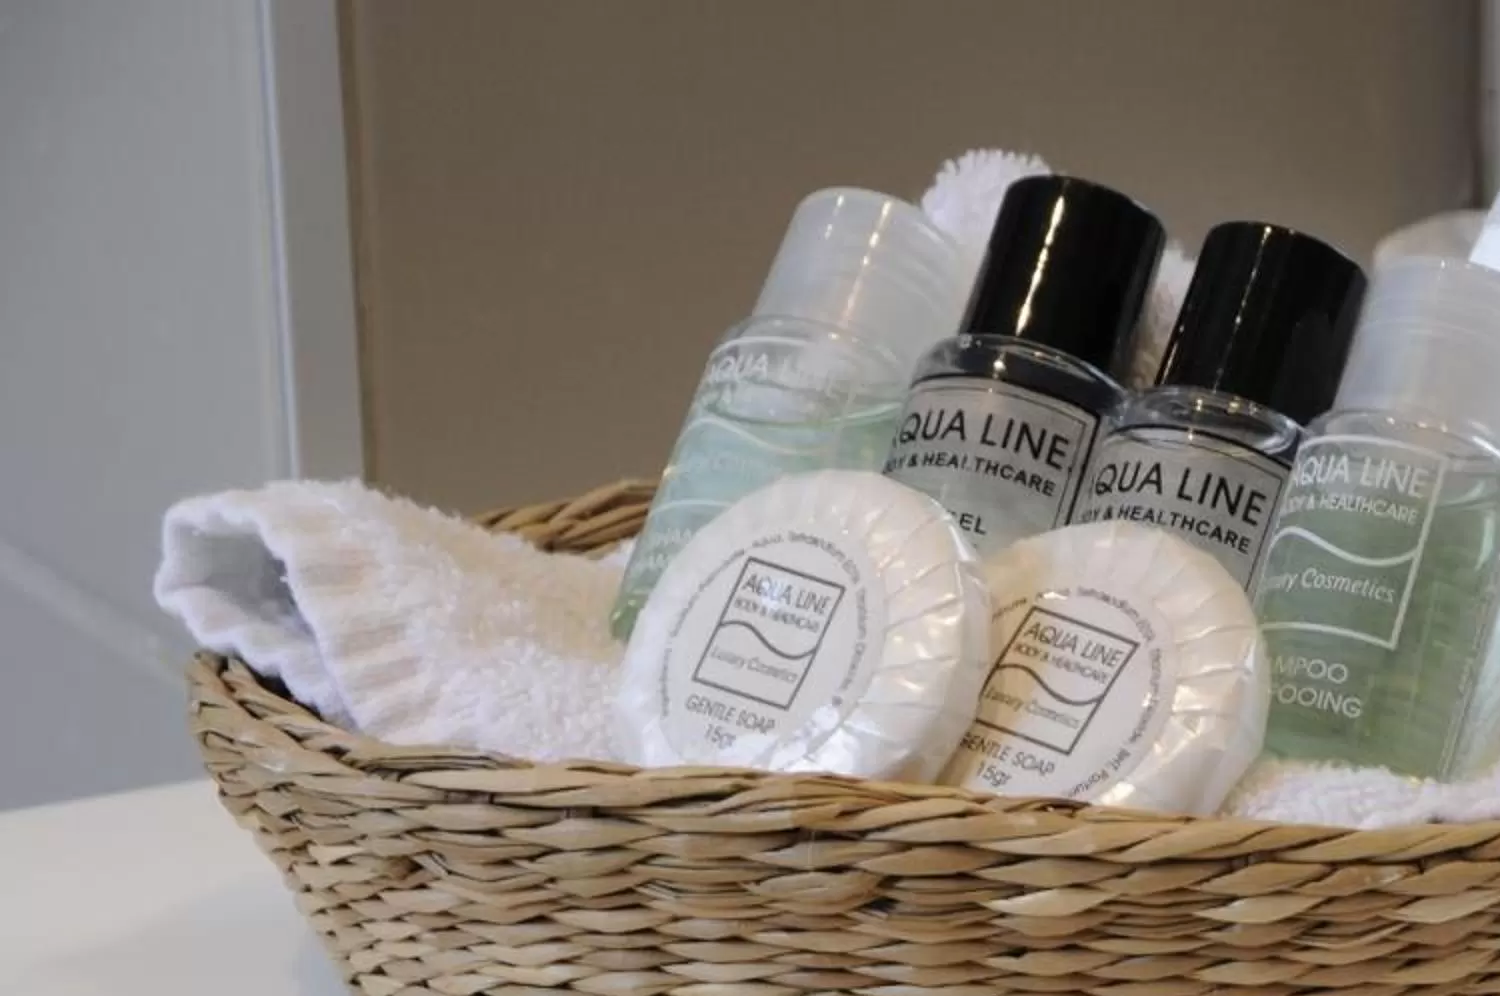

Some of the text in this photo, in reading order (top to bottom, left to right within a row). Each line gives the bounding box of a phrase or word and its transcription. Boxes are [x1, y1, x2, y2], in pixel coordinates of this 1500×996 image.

[893, 409, 1069, 470] QUA LINE
[921, 451, 1056, 497] HEALTHCARE
[1090, 461, 1266, 526] QUA LINE
[1359, 456, 1429, 498] LINE
[950, 510, 987, 536] EL
[1117, 503, 1252, 555] HEALTHCARE
[1319, 494, 1420, 525] HEALTHCARE
[741, 573, 831, 616] AQUA LINE
[1301, 567, 1396, 603] Cosmetics
[1023, 622, 1125, 668] AQUA LINE
[1274, 656, 1348, 684] MPOO
[685, 693, 776, 735] GENTLE SOAP
[1268, 682, 1362, 718] OOING
[1012, 751, 1055, 777] SOAP
